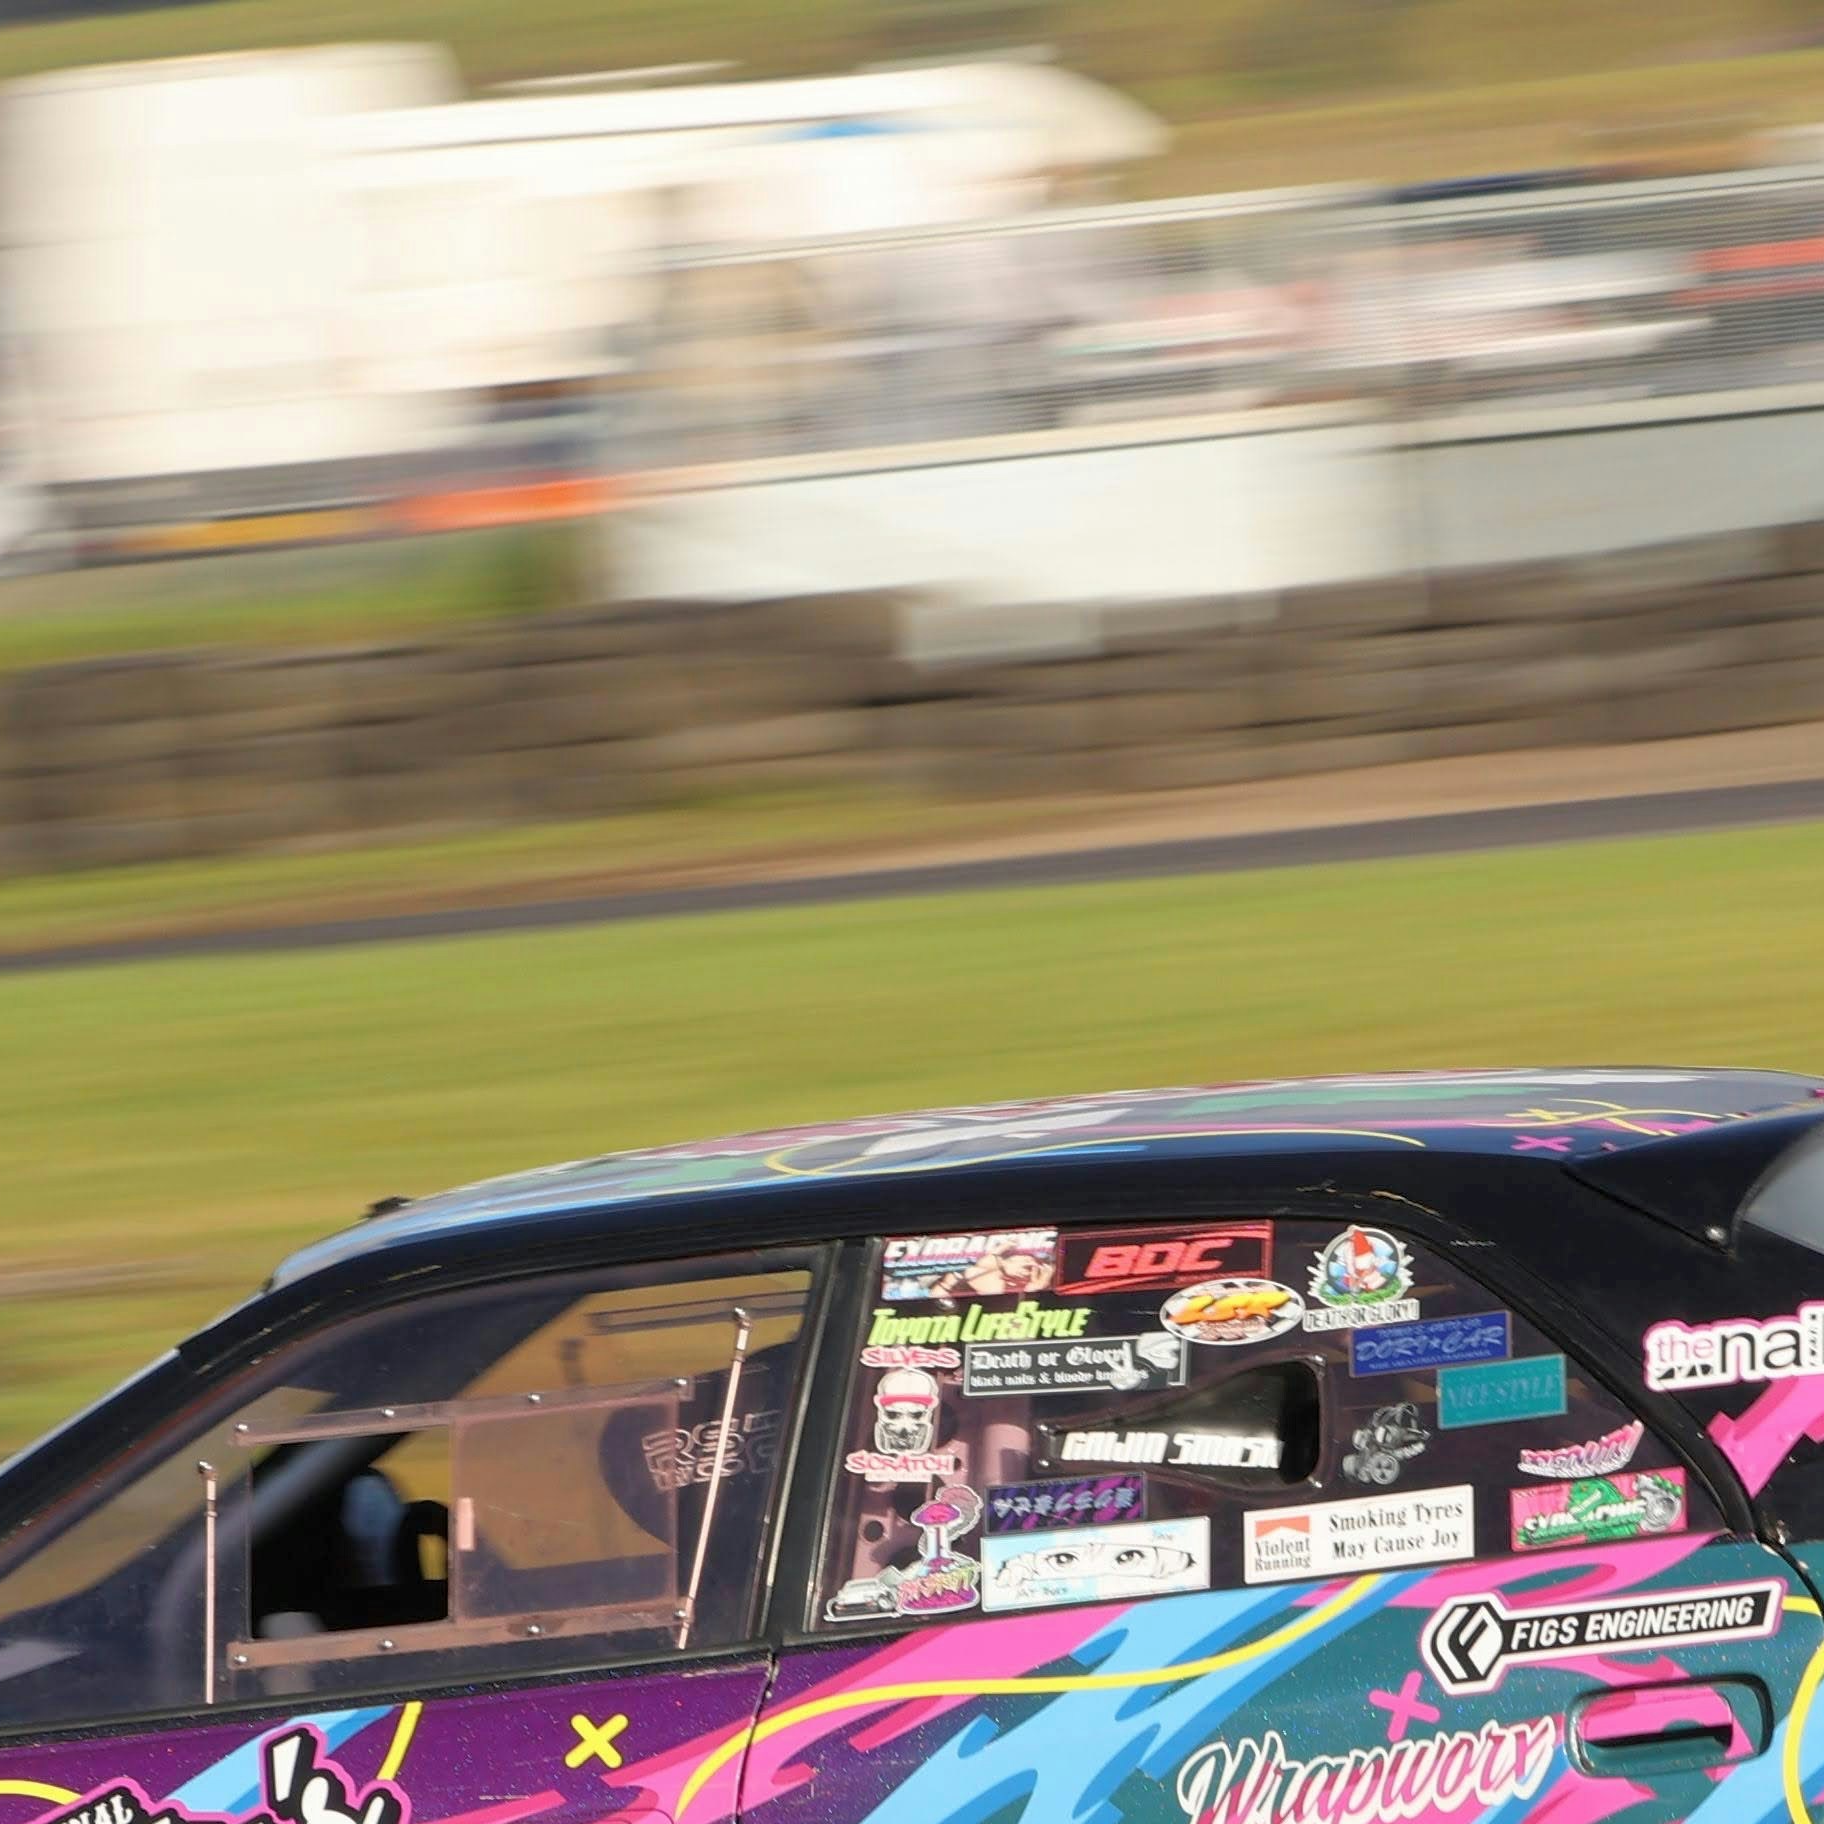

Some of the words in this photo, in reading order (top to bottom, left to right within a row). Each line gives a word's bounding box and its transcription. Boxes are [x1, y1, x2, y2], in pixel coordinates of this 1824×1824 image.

[1085, 1238, 1235, 1279] BDC
[1038, 1352, 1060, 1367] or
[1657, 1334, 1714, 1361] the
[845, 1451, 953, 1473] SCRATCH
[1329, 1507, 1406, 1533] Smoking
[1413, 1502, 1464, 1525] Tyres
[1255, 1537, 1311, 1559] Violent
[1332, 1541, 1366, 1560] May
[1374, 1532, 1425, 1555] Cause
[1432, 1528, 1461, 1548] Joy
[1254, 1554, 1311, 1573] Running
[1510, 1614, 1578, 1649] FIGS
[1584, 1596, 1755, 1642] ENGINEERING
